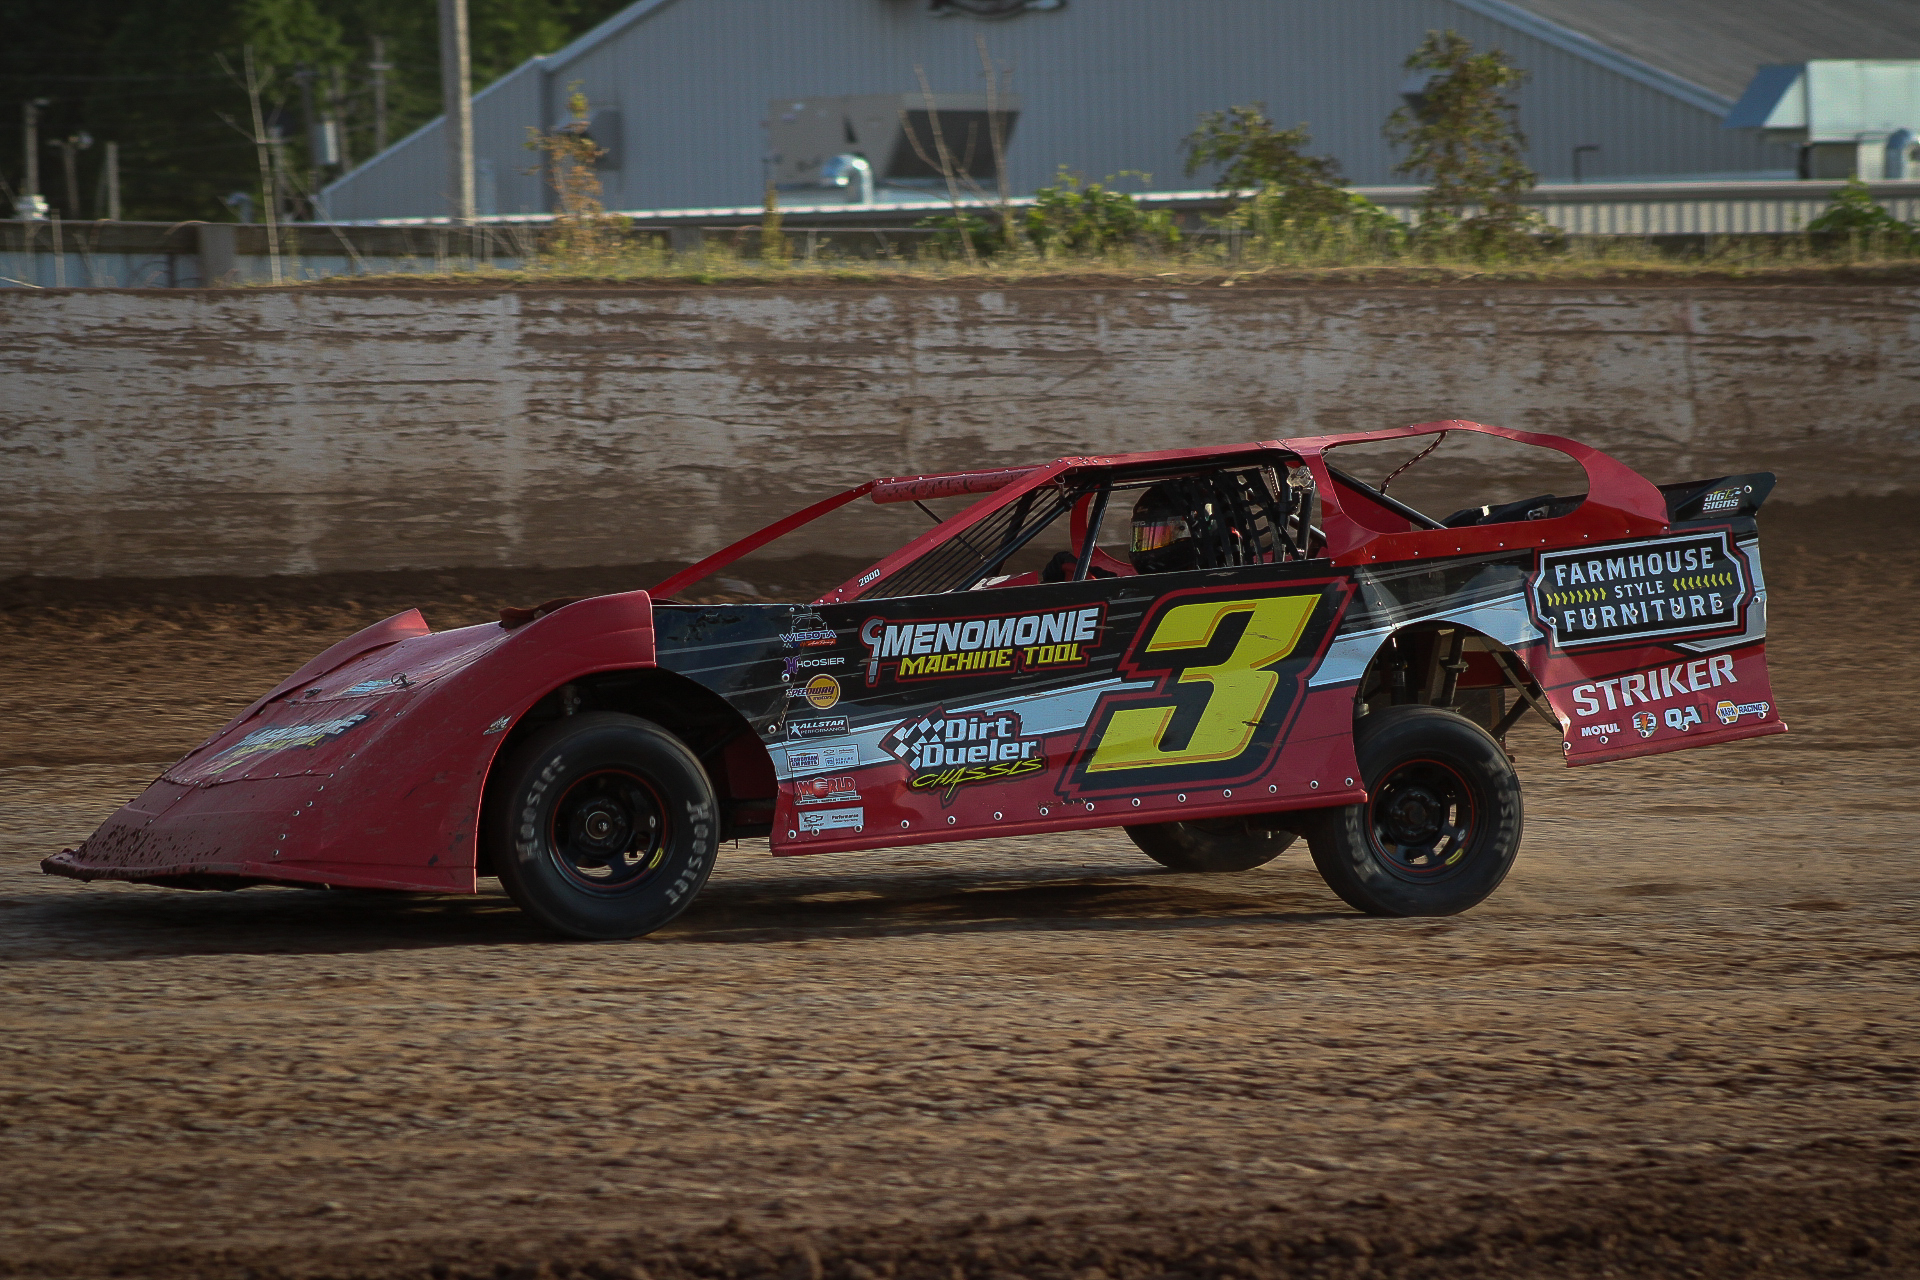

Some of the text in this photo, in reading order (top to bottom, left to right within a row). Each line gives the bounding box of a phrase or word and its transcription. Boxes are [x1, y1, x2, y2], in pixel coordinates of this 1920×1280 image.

[1702, 499, 1739, 510] SIGNS
[858, 568, 881, 587] 2800
[1554, 547, 1715, 587] FARMHOUSE
[1614, 580, 1666, 599] STYLE
[1564, 592, 1724, 633] FURNITURE
[779, 629, 837, 642] WISSOTA
[881, 608, 1100, 658] MENOMONIE
[797, 657, 845, 668] HOOSIER
[899, 643, 1083, 676] MACHINE TOOL
[786, 686, 835, 698] SPEEDWAY
[1085, 593, 1323, 774] 3
[1572, 654, 1738, 716] STRIKER
[1719, 703, 1763, 717] NAPA RACING
[800, 720, 845, 729] ALLSTAR
[945, 717, 1012, 743] Dirt
[1581, 722, 1621, 737] MOTUL
[921, 738, 1037, 768] Dueler
[911, 757, 1044, 799] CHASSIS
